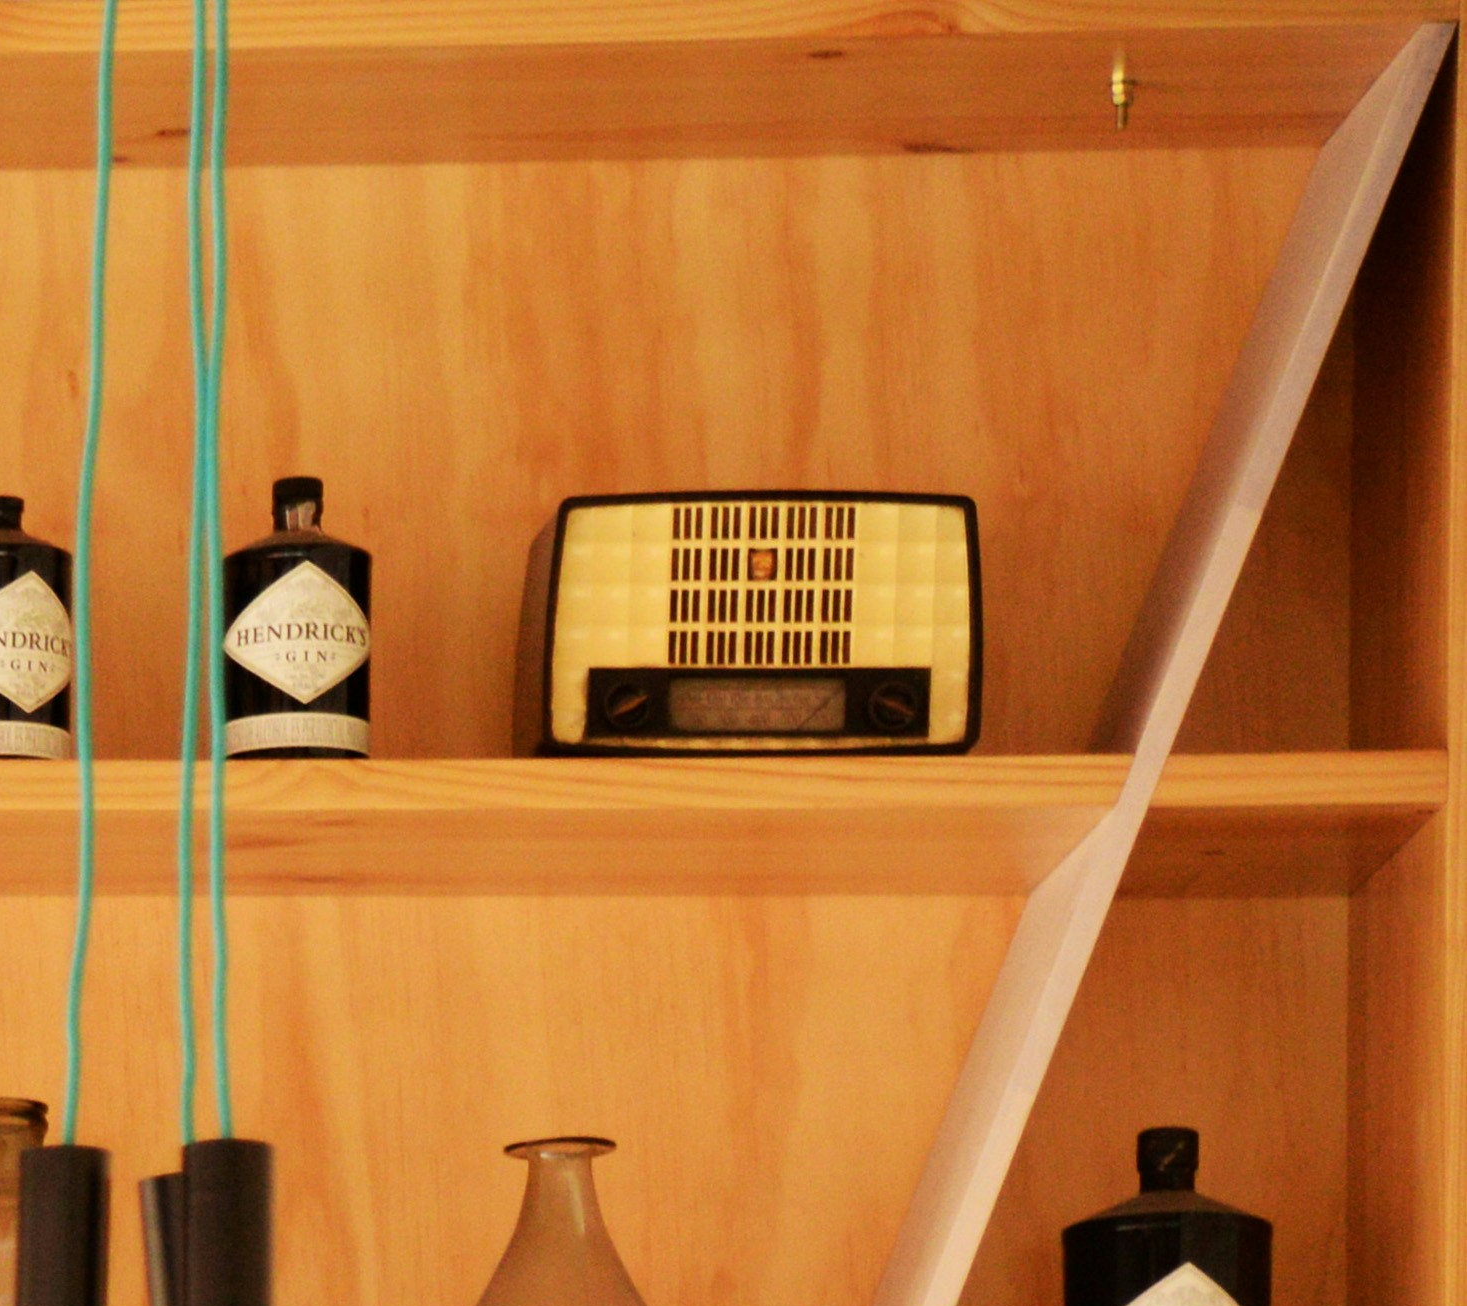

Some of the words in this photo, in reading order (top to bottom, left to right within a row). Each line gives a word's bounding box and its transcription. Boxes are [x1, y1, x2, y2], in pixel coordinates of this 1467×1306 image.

[236, 622, 369, 651] HENDRICK'S
[285, 648, 330, 665] GIN
[10, 659, 47, 672] GIN
